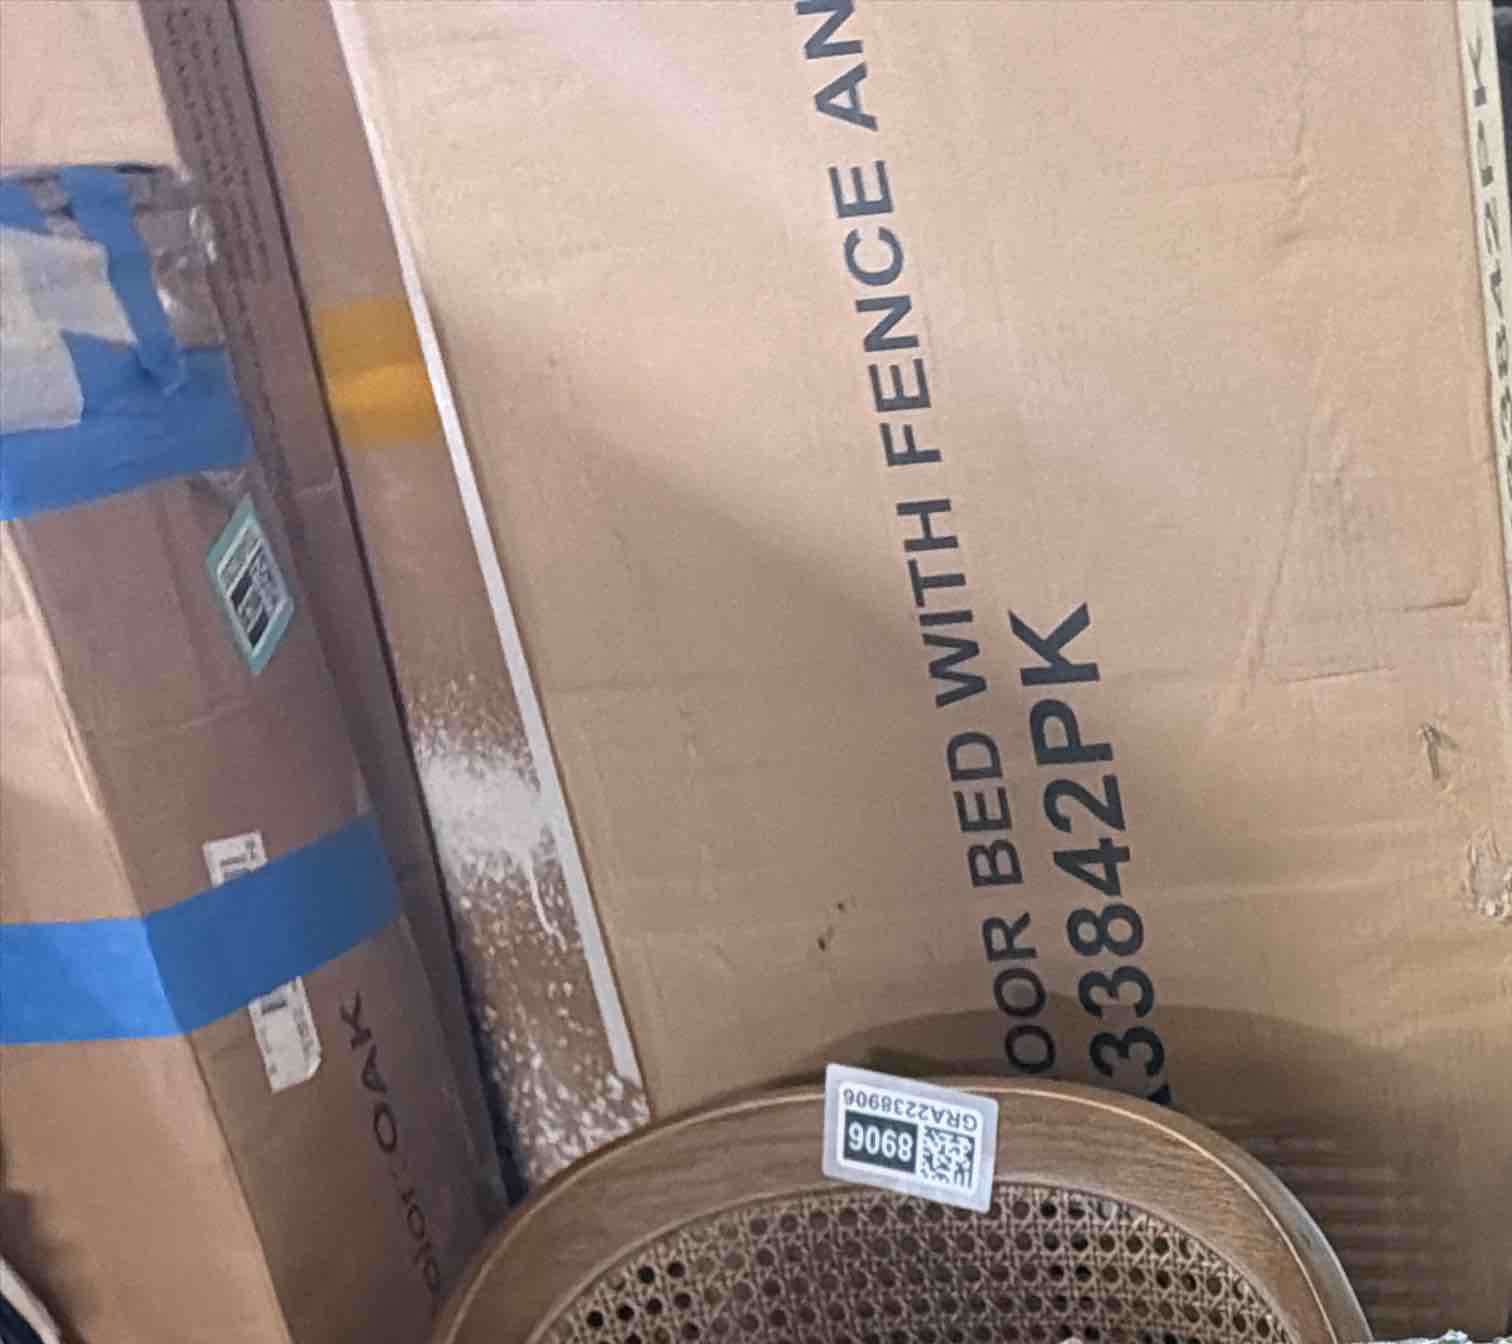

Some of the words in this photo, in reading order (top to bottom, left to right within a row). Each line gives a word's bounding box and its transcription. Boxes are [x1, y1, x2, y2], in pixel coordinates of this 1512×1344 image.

[803, 0, 877, 132] AN
[829, 160, 943, 467] FENCE
[896, 497, 989, 708] WITH
[947, 729, 1022, 887] BED
[1009, 603, 1172, 1105] 33842PK
[340, 992, 399, 1154] OAK
[843, 1088, 978, 1132] GRA2238906
[849, 1122, 913, 1162] 8906
